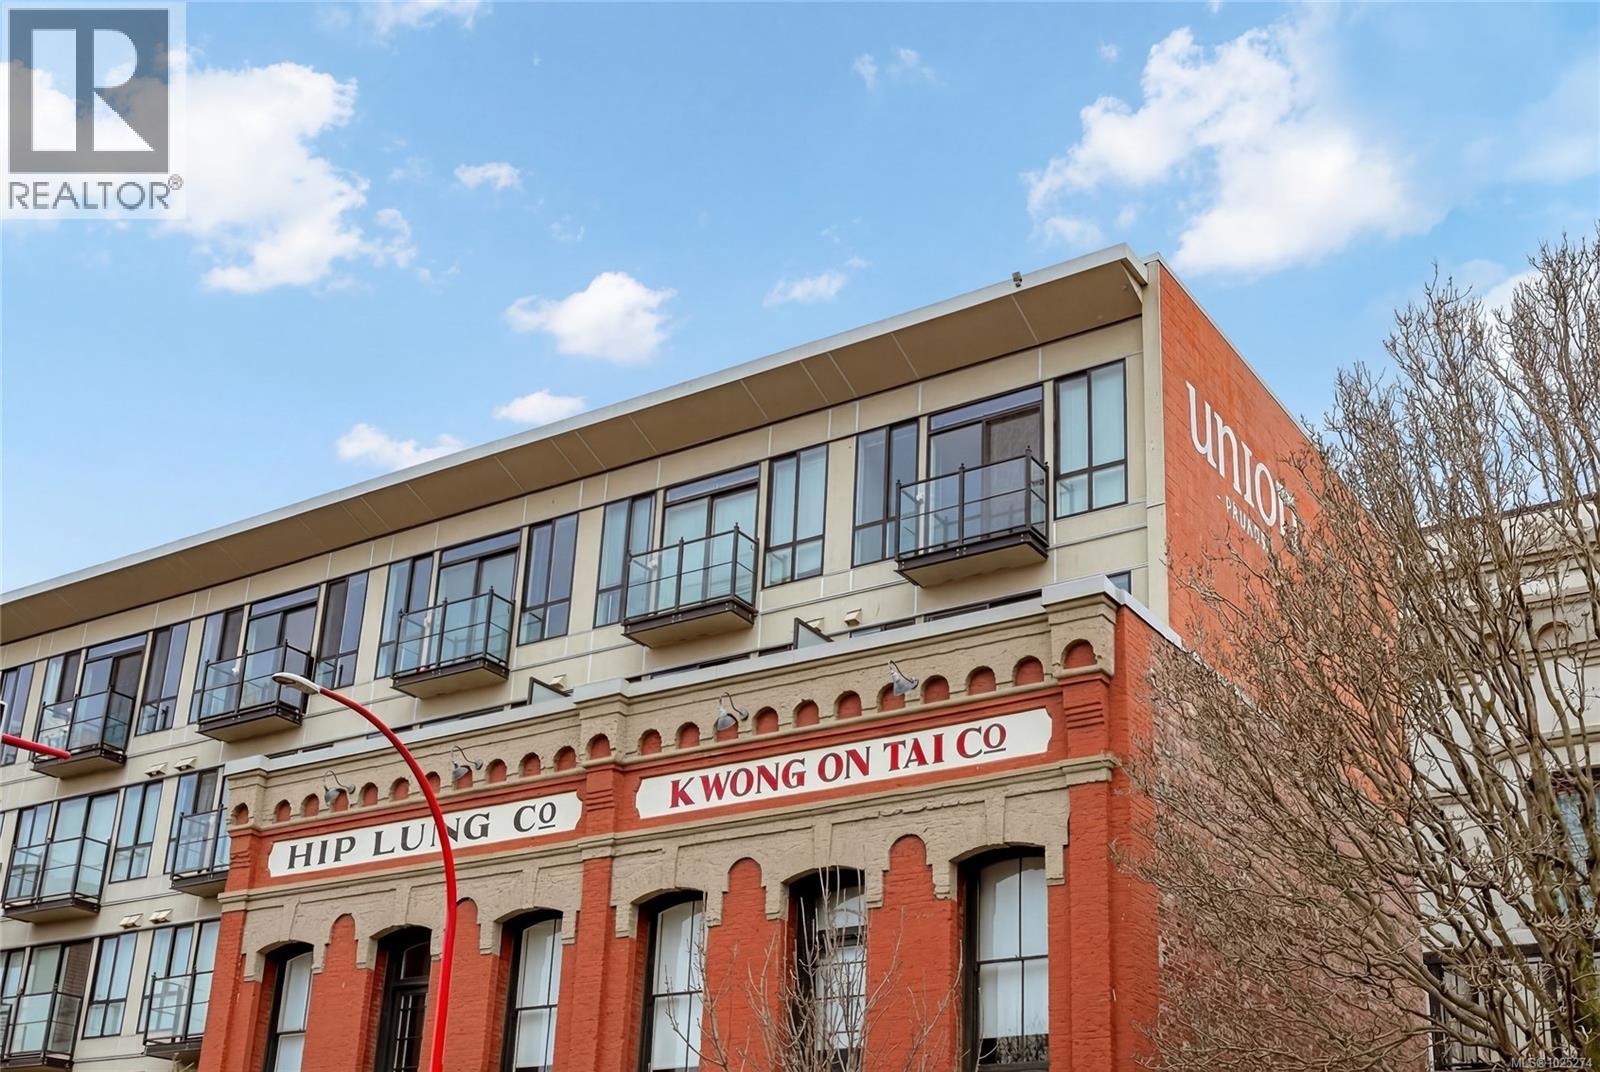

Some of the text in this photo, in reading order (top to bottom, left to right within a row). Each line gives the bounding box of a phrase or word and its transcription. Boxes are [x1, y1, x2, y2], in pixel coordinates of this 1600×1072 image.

[669, 757, 806, 809] KWONG
[817, 745, 871, 783] ON
[883, 733, 944, 772] TAI
[287, 835, 356, 870] HIP
[372, 811, 491, 857] LUNG
